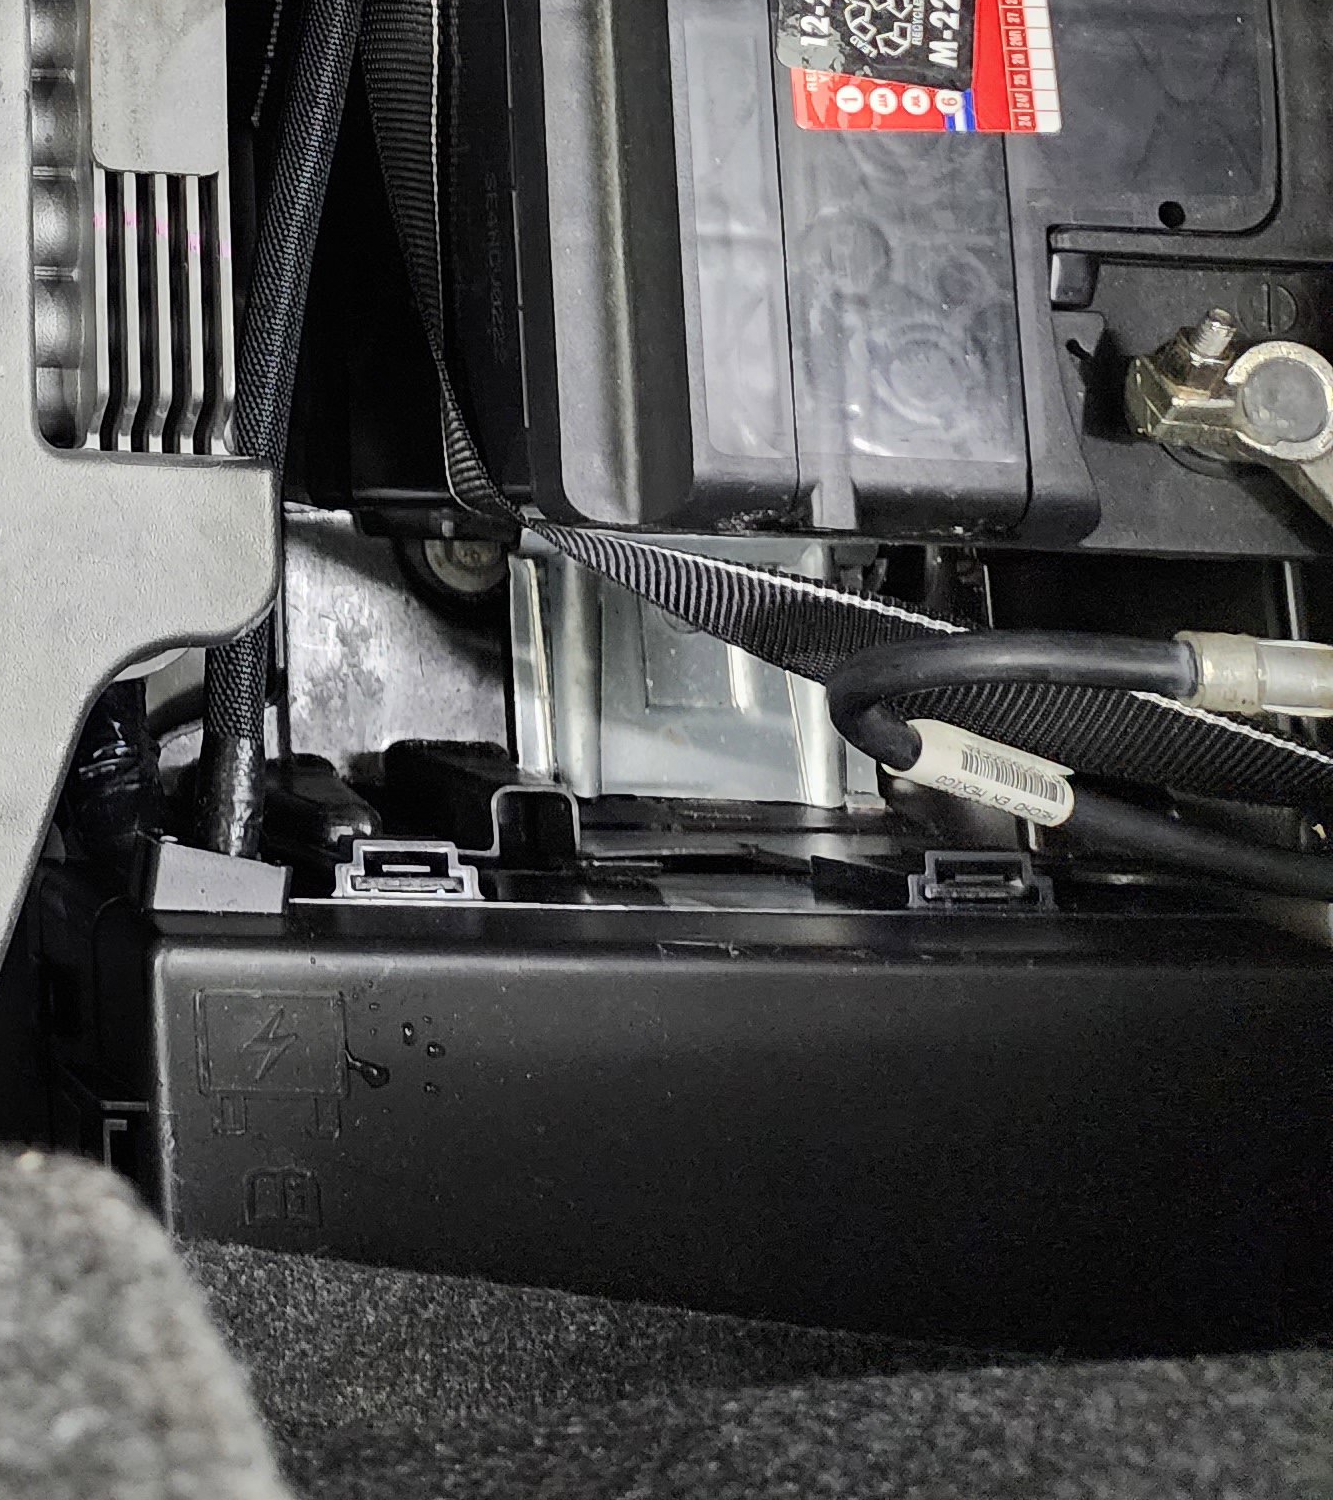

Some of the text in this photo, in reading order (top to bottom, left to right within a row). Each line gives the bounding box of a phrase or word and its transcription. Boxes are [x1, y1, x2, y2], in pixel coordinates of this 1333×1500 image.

[849, 34, 879, 59] LEAD
[941, 98, 958, 107] 6
[935, 775, 988, 798] MEXICO
[992, 794, 1011, 806] EN
[1014, 802, 1058, 821] HECHO
